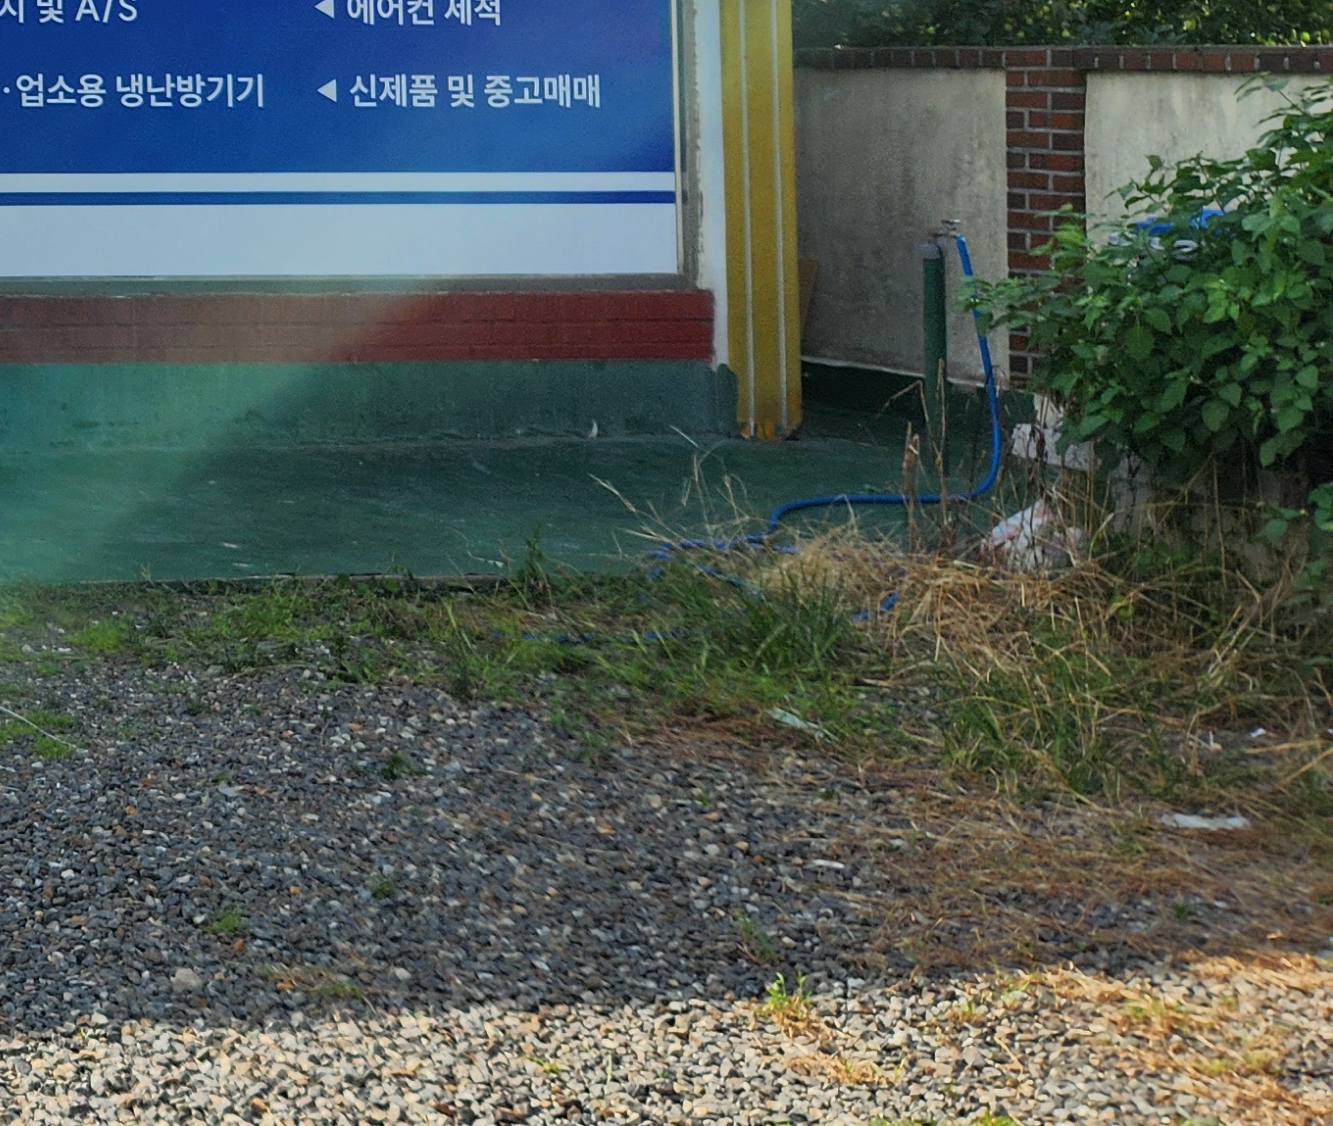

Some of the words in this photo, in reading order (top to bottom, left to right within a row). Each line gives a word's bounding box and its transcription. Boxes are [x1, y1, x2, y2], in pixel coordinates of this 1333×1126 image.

[116, 74, 263, 108] 냉난방기기
[349, 74, 438, 108] 신제품
[448, 75, 474, 107] 및
[483, 75, 600, 109] 중고매매
